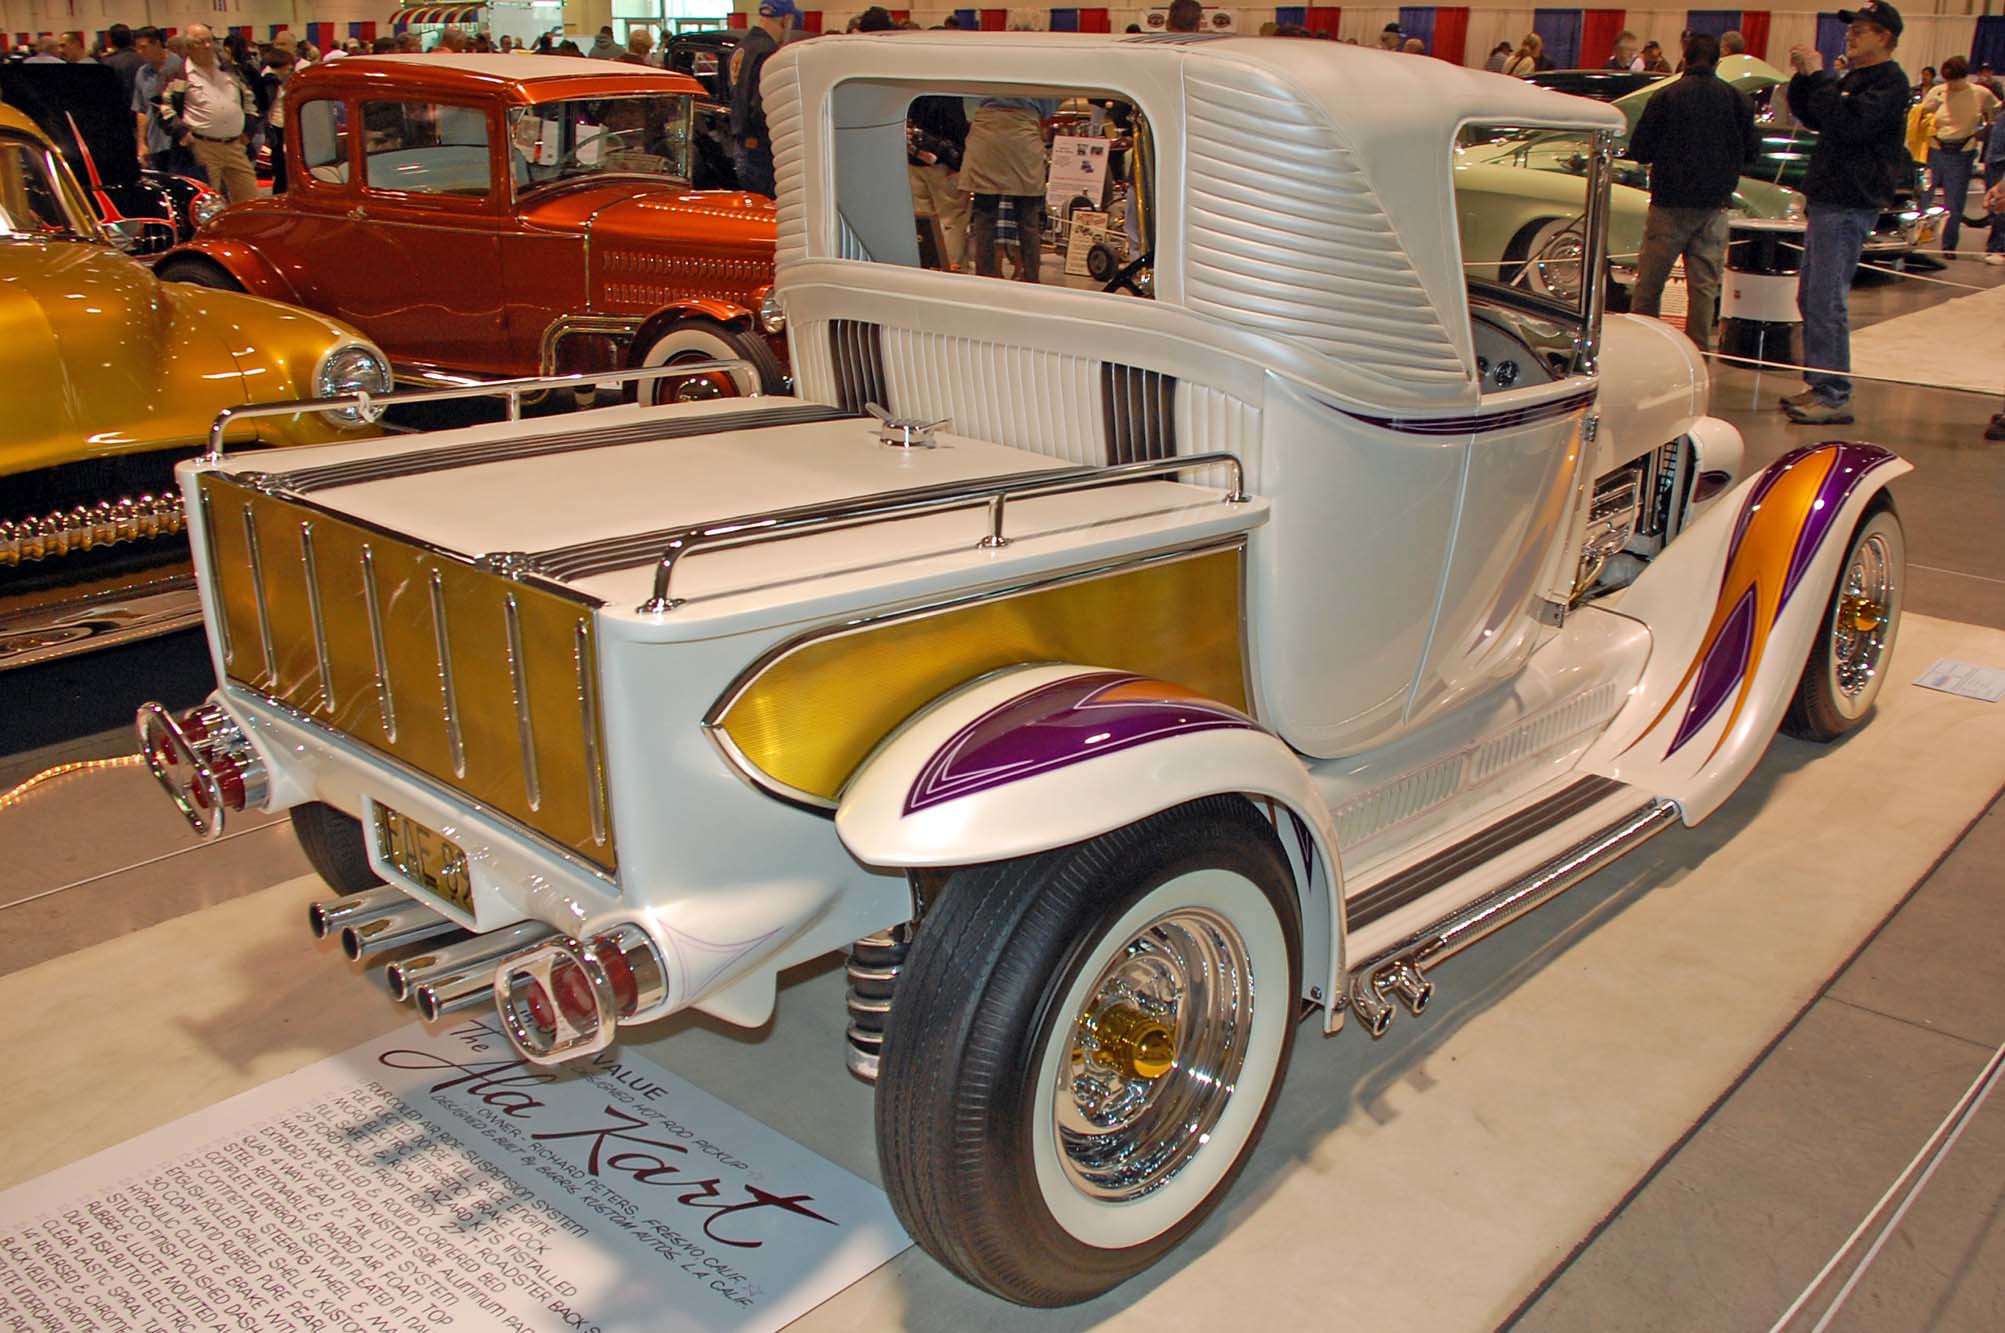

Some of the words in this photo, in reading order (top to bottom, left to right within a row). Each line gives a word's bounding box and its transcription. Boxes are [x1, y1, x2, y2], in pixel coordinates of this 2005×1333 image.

[449, 1019, 506, 1053] The
[588, 1053, 668, 1101] VALUE
[242, 1136, 274, 1157] QUAD
[279, 1163, 309, 1183] WAY
[301, 1183, 336, 1207] HEAD
[330, 1207, 348, 1219] &
[347, 1217, 373, 1240] TAIL
[369, 1238, 403, 1261] LITE
[259, 1126, 308, 1160] EXTRUDED
[300, 1160, 318, 1169] &
[313, 1168, 346, 1191] GOLD
[340, 1190, 373, 1212] DYED
[412, 1246, 443, 1268] SIDE
[335, 1120, 378, 1150] SAFETY
[385, 1158, 423, 1183] ROAD
[419, 1183, 474, 1222] HAZARD
[468, 1219, 505, 1245] KITS
[502, 1244, 577, 1297] INSTALLED
[347, 1089, 373, 1107] FUEL
[410, 1134, 452, 1162] DODGE
[447, 1161, 476, 1182] FULL
[474, 1180, 512, 1206] RACE
[361, 1120, 415, 1156] ELECTRIC
[470, 1199, 514, 1228] BRAKE
[509, 1227, 552, 1256] LOCK
[379, 1050, 557, 1119] Ala
[532, 1105, 840, 1248] Kart
[528, 1142, 586, 1179] RICHARD
[0, 1236, 33, 1265] BLACK
[32, 1239, 82, 1284] REVERSED
[71, 1284, 90, 1295] &
[42, 1220, 78, 1249] CLEAR
[69, 1247, 115, 1286] PLASTIC
[107, 1286, 145, 1320] SPIRAL
[62, 1210, 92, 1235] DUAL
[85, 1232, 117, 1256] PUSH
[85, 1201, 124, 1235] RUBBER
[115, 1233, 134, 1243] &
[126, 1241, 170, 1276] LUCITE
[106, 1193, 152, 1232] STUCCO
[144, 1229, 184, 1260] FINISH
[175, 1258, 231, 1304] POLISHED
[126, 1184, 181, 1229] HYDRAULIC
[174, 1229, 220, 1265] CLUTCH
[212, 1265, 231, 1276] &
[225, 1276, 269, 1310] BRAKE
[145, 1176, 170, 1191] 30
[162, 1190, 198, 1215] COAT
[189, 1214, 225, 1241] HAND
[216, 1239, 262, 1274] RUBBED
[256, 1274, 292, 1302] PURE
[165, 1166, 209, 1200] ENGLISH
[200, 1198, 242, 1229] ROLLED
[234, 1228, 275, 1258] GRILLE
[268, 1257, 306, 1290] SHELL
[302, 1288, 320, 1299] &
[184, 1158, 208, 1169] 57
[260, 1223, 314, 1265] STEERING
[310, 1264, 351, 1301] WHEEL
[350, 1302, 369, 1314] &
[223, 1142, 255, 1168] STEEL
[306, 1212, 324, 1222] &
[320, 1221, 363, 1254] PADDED
[357, 1255, 384, 1272] AIR
[421, 1302, 454, 1325] TOP
[295, 1112, 316, 1123] 29
[309, 1121, 344, 1144] FORD
[404, 1193, 443, 1218] BODY
[547, 1300, 589, 1330] BACK
[330, 1159, 372, 1188] ROLLED
[365, 1188, 382, 1199] &
[477, 1272, 507, 1293] BED
[345, 1268, 395, 1306] PLEATED
